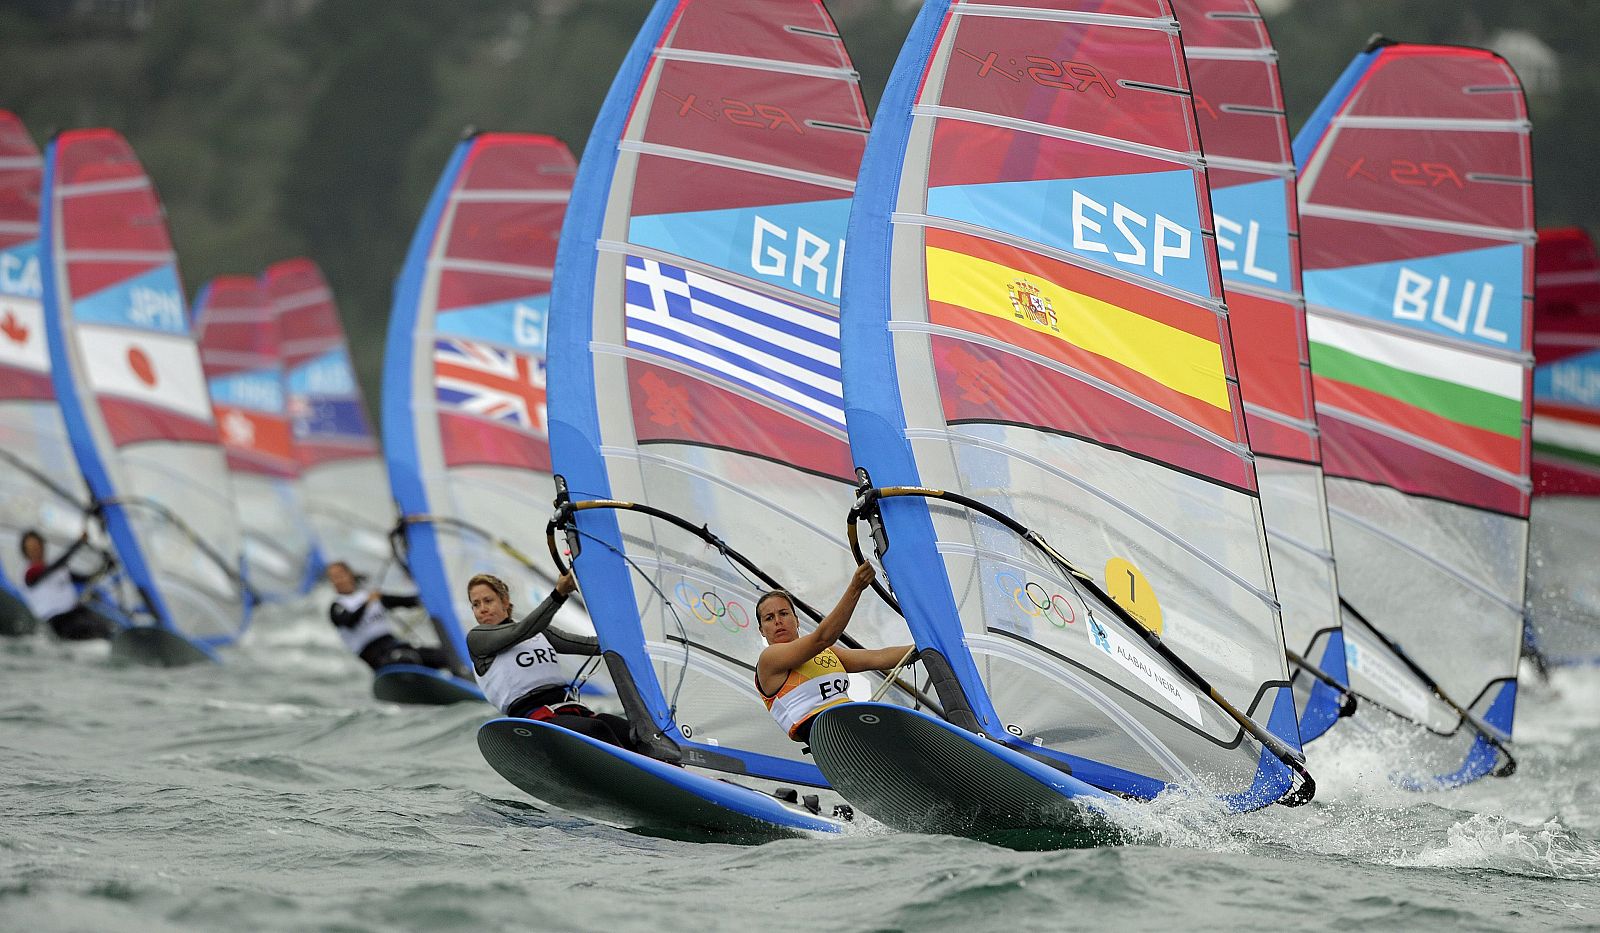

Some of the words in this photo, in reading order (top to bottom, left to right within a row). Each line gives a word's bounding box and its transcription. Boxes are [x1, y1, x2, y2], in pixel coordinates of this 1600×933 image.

[1072, 189, 1191, 276] ESP
[513, 302, 549, 348] G
[1392, 267, 1508, 344] BUL
[1126, 568, 1136, 604] 1
[515, 646, 559, 668] GRE
[1117, 645, 1153, 678] ALABAU
[1153, 671, 1183, 700] NEIRA
